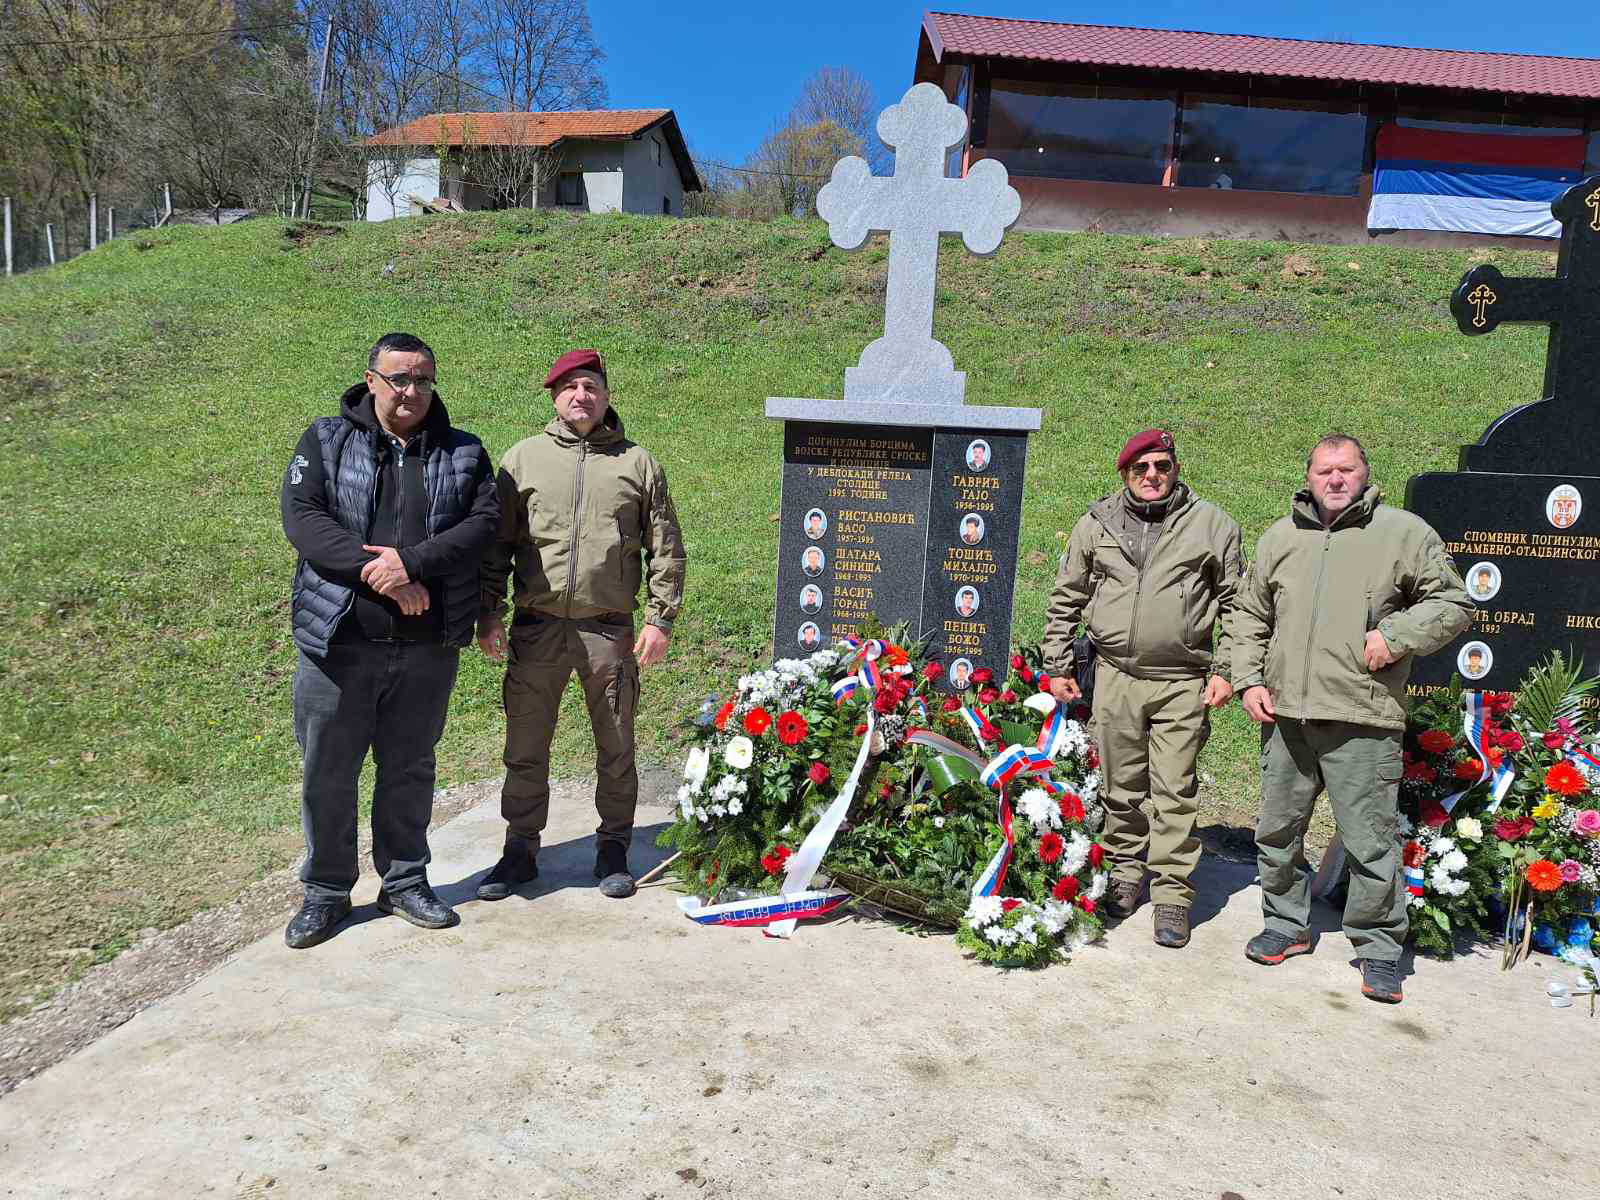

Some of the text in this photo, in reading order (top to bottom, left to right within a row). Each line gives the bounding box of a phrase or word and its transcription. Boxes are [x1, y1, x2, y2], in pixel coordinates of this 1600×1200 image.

[952, 475, 1000, 489] ГАВРИЋ
[962, 489, 988, 500] ГАЈО
[838, 511, 915, 524] РИСТАНОВИЋ
[837, 522, 866, 533] ВАСО
[1464, 531, 1528, 544] СПОМЕНИК
[836, 548, 881, 560] ШАТАРА
[948, 548, 993, 561] ТОШИЋ
[1445, 542, 1600, 560] ДБРАМБЕНО-ОТАЏБИНСКОГ
[944, 560, 997, 573] МИХАЈЛО
[834, 586, 873, 599] ВАСИЋ
[832, 598, 867, 610] ГОРАН
[1494, 611, 1535, 625] ОБРАД
[948, 634, 980, 645] БОЖО
